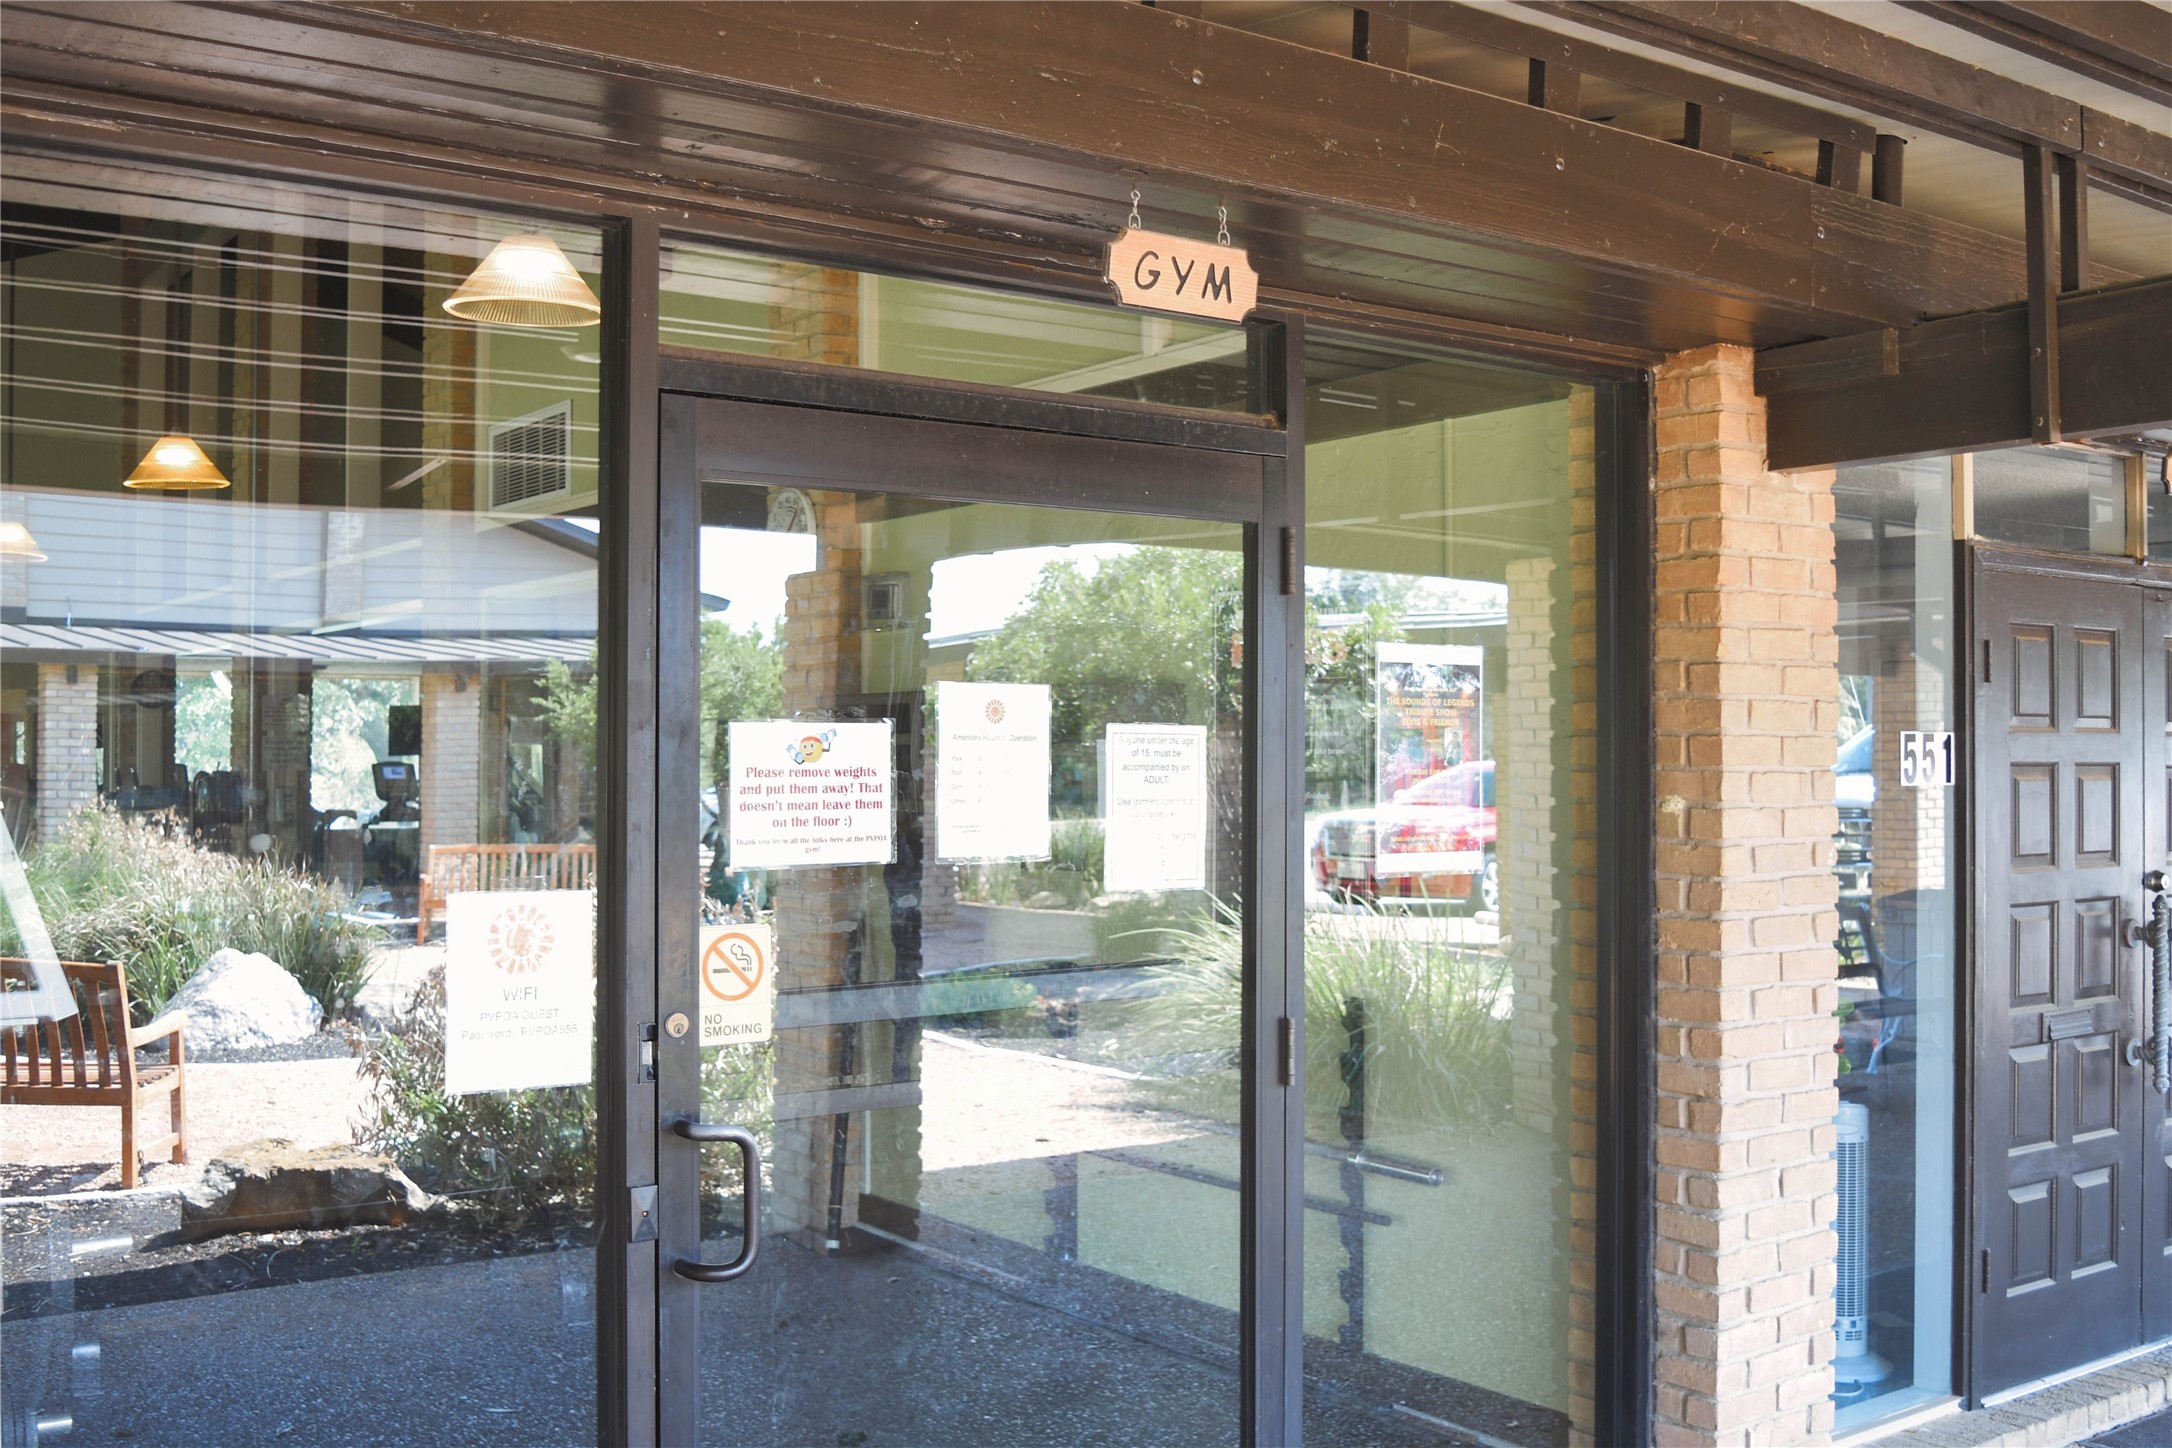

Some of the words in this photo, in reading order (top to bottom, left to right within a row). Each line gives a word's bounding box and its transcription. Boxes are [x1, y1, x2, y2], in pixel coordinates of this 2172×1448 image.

[1135, 250, 1232, 304] GYM
[1182, 738, 1194, 746] age
[1132, 749, 1139, 757] of
[1904, 734, 1951, 784] 551
[746, 767, 784, 778] Please
[789, 768, 830, 778] remove
[834, 767, 877, 779] weights
[1123, 763, 1169, 773] accompanied
[1171, 763, 1180, 773] by
[1144, 776, 1168, 784] ADULT
[739, 784, 761, 795] and
[766, 784, 784, 796] put
[790, 783, 818, 794] them
[822, 783, 854, 796] away!
[858, 782, 883, 793] That
[787, 801, 818, 810] mean
[822, 799, 850, 810] leave
[855, 799, 883, 809] them
[773, 818, 787, 828] on
[792, 817, 809, 827] the
[813, 816, 840, 826] floor
[845, 816, 852, 828] :)
[522, 1009, 559, 1020] GUEST
[705, 1014, 722, 1024] NO
[705, 1023, 762, 1037] SMOKING
